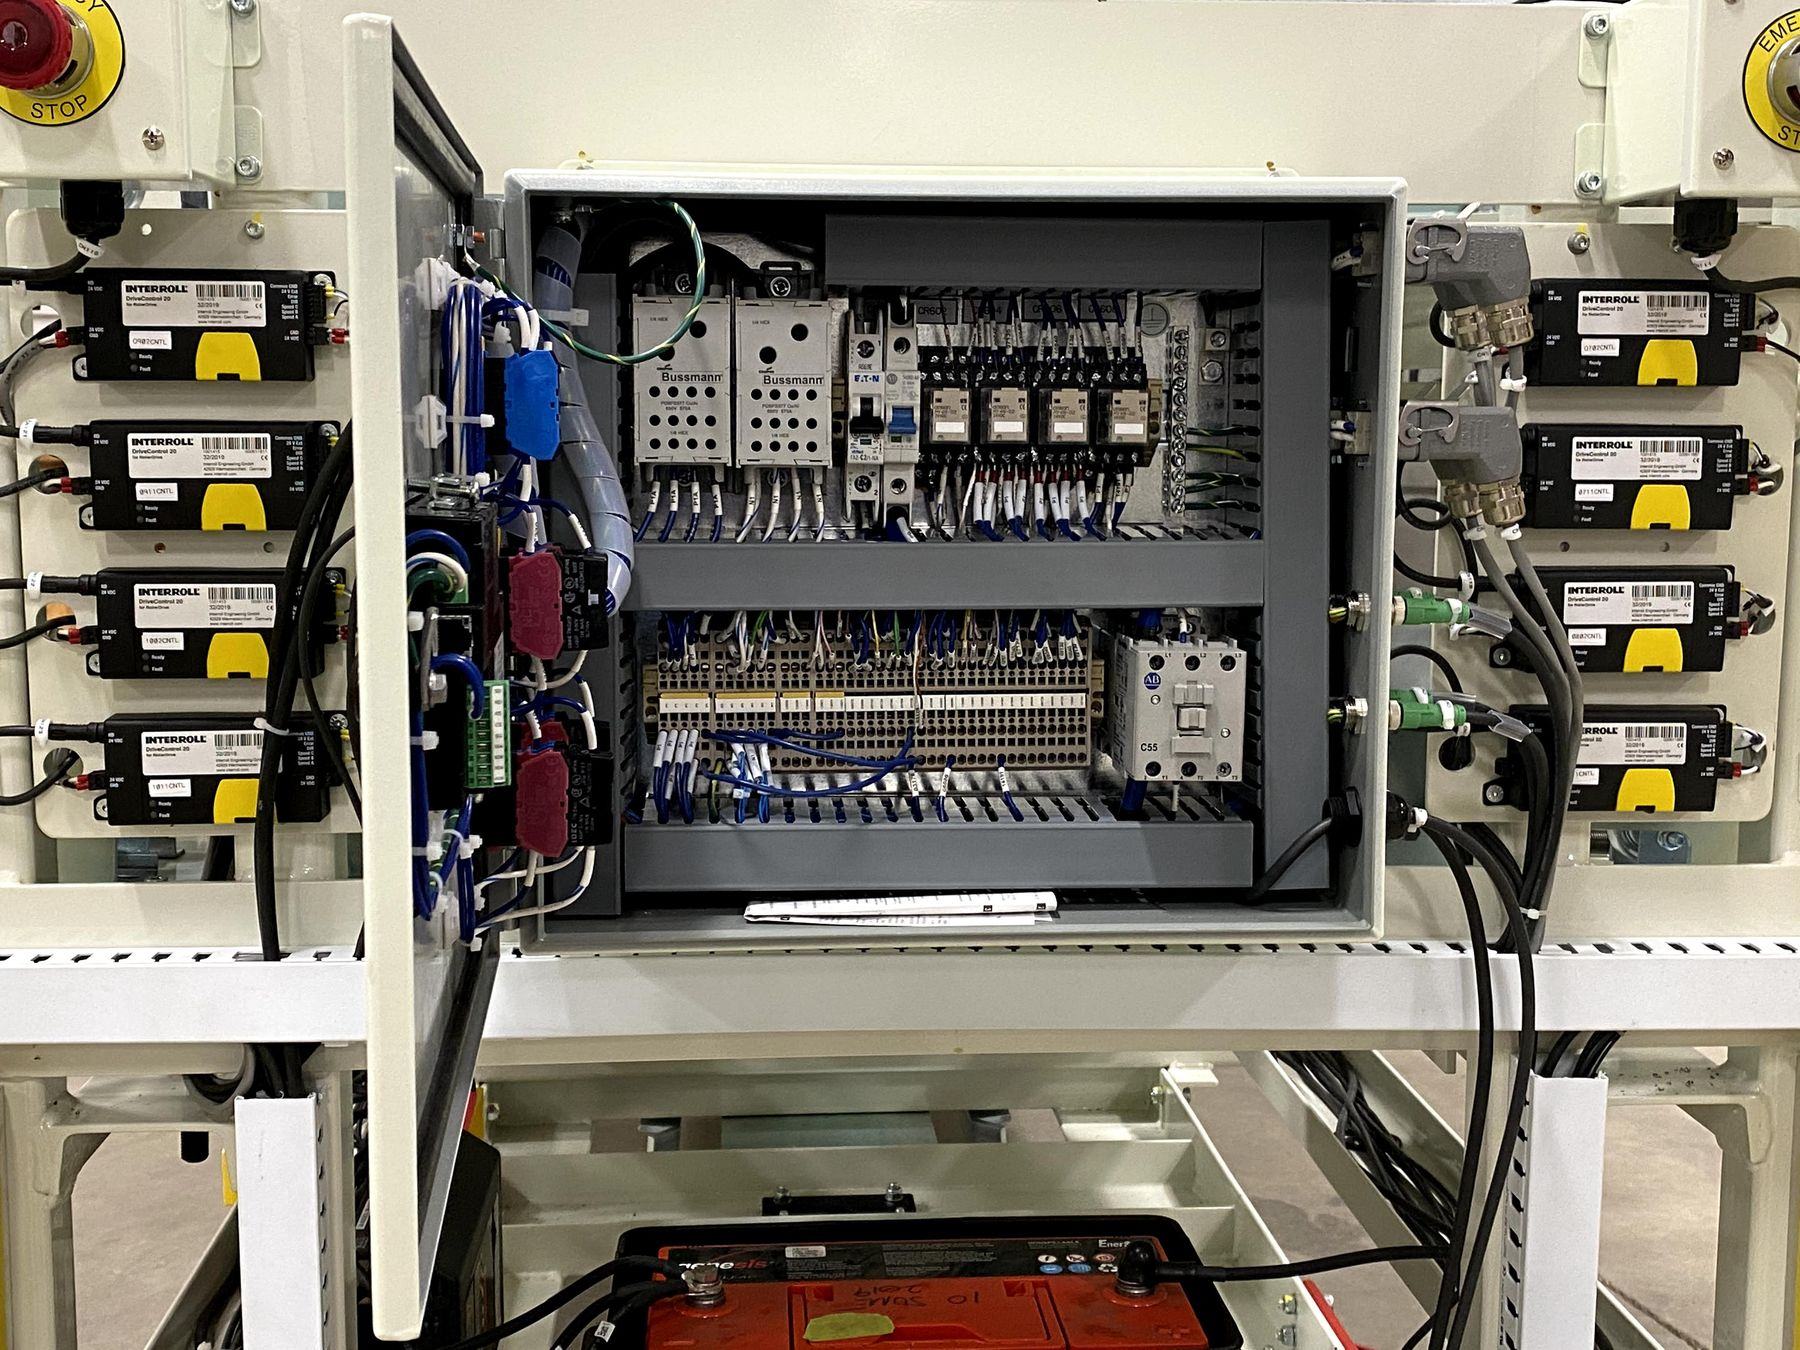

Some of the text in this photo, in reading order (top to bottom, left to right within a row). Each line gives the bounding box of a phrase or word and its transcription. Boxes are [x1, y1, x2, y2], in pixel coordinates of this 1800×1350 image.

[31, 95, 87, 119] STOP
[125, 285, 187, 293] INTERROLL
[1582, 296, 1639, 304] INTERROLL
[661, 372, 723, 383] Bussmann
[763, 375, 825, 386] Bussmann
[132, 438, 193, 446] INTERROLL
[1576, 441, 1632, 449] INTERROLL
[138, 588, 200, 596] INTERROLL
[1568, 586, 1624, 594] INTERROLL
[1146, 675, 1159, 684] AB
[145, 736, 207, 744] INTERROLL
[1141, 743, 1157, 751] C55
